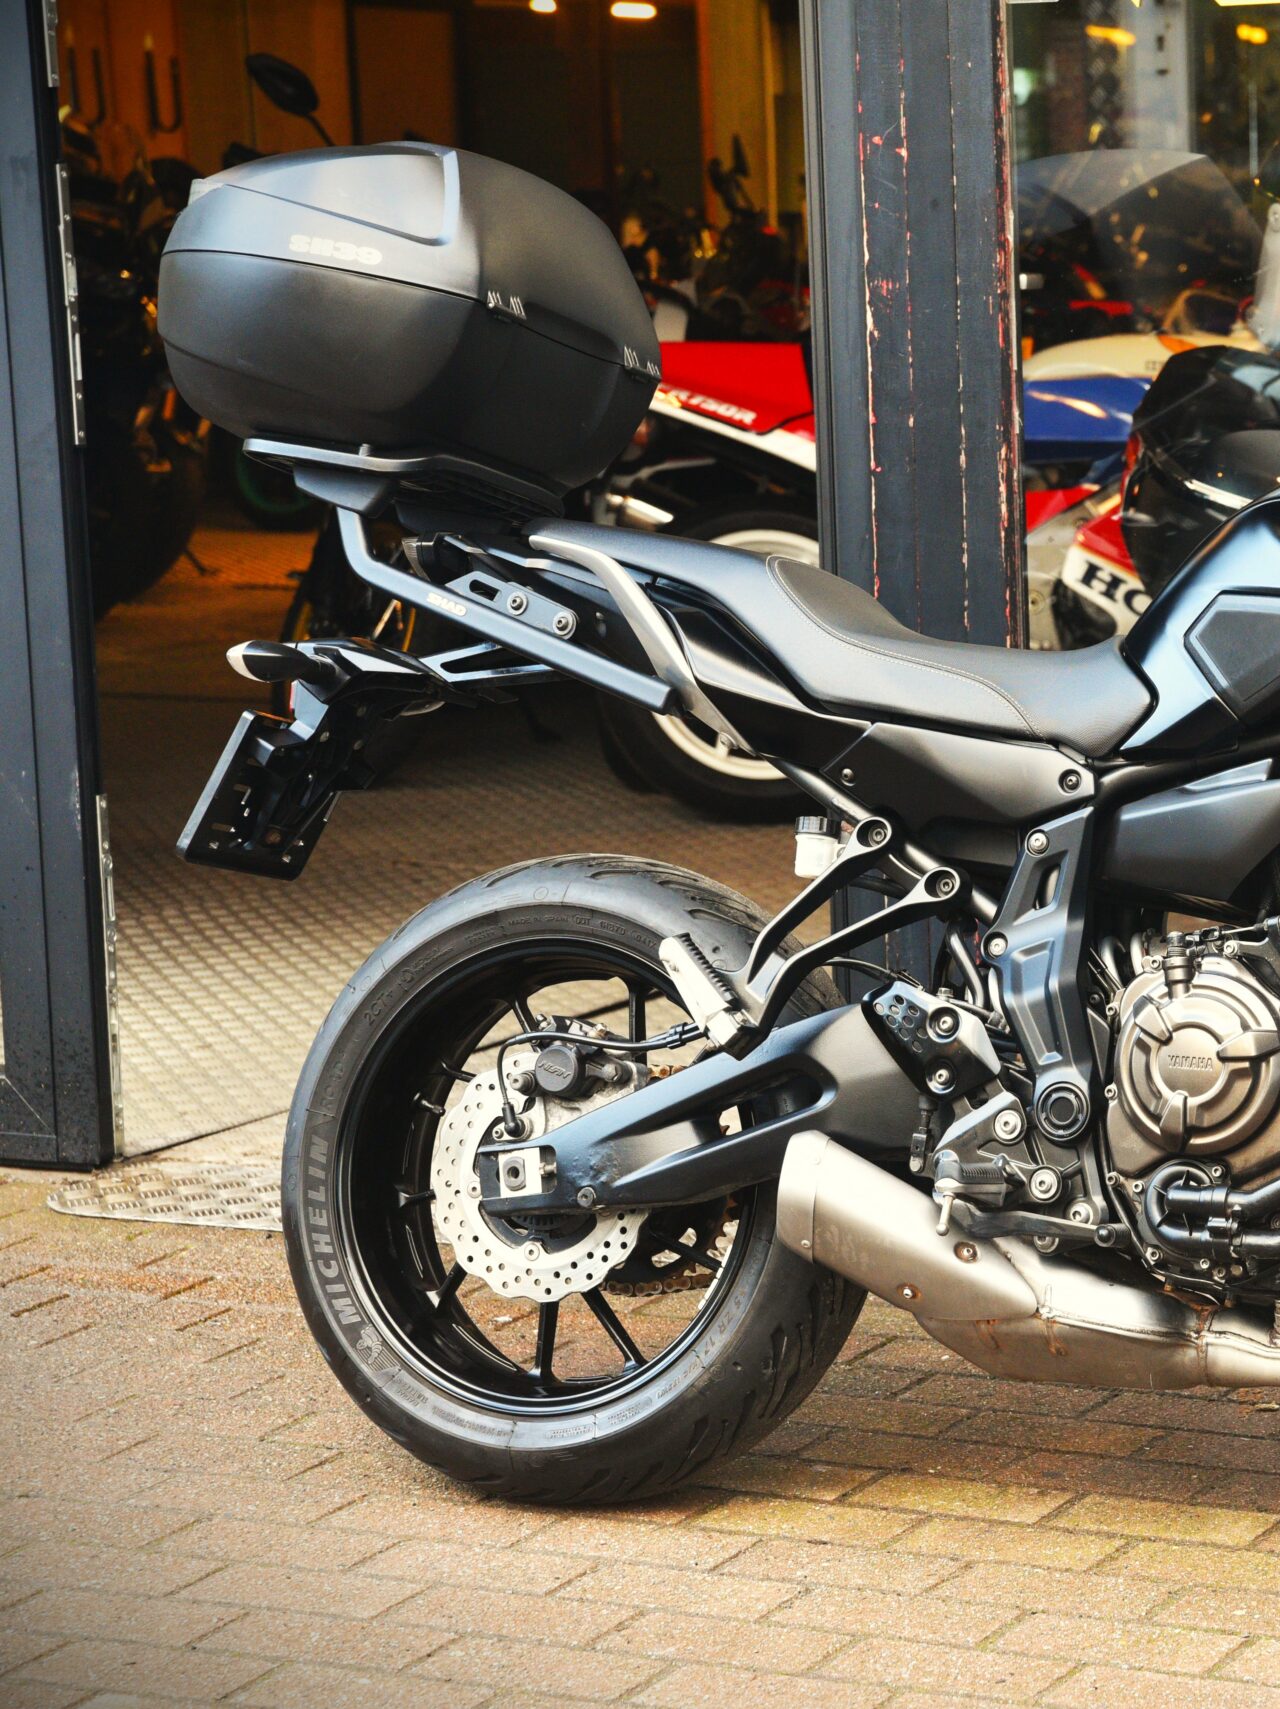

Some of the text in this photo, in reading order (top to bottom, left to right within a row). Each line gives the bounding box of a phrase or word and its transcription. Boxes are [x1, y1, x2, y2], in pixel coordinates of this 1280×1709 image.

[427, 592, 467, 618] SHAD
[1167, 1054, 1214, 1072] YAMAHA
[307, 1134, 362, 1326] MICHELIN
